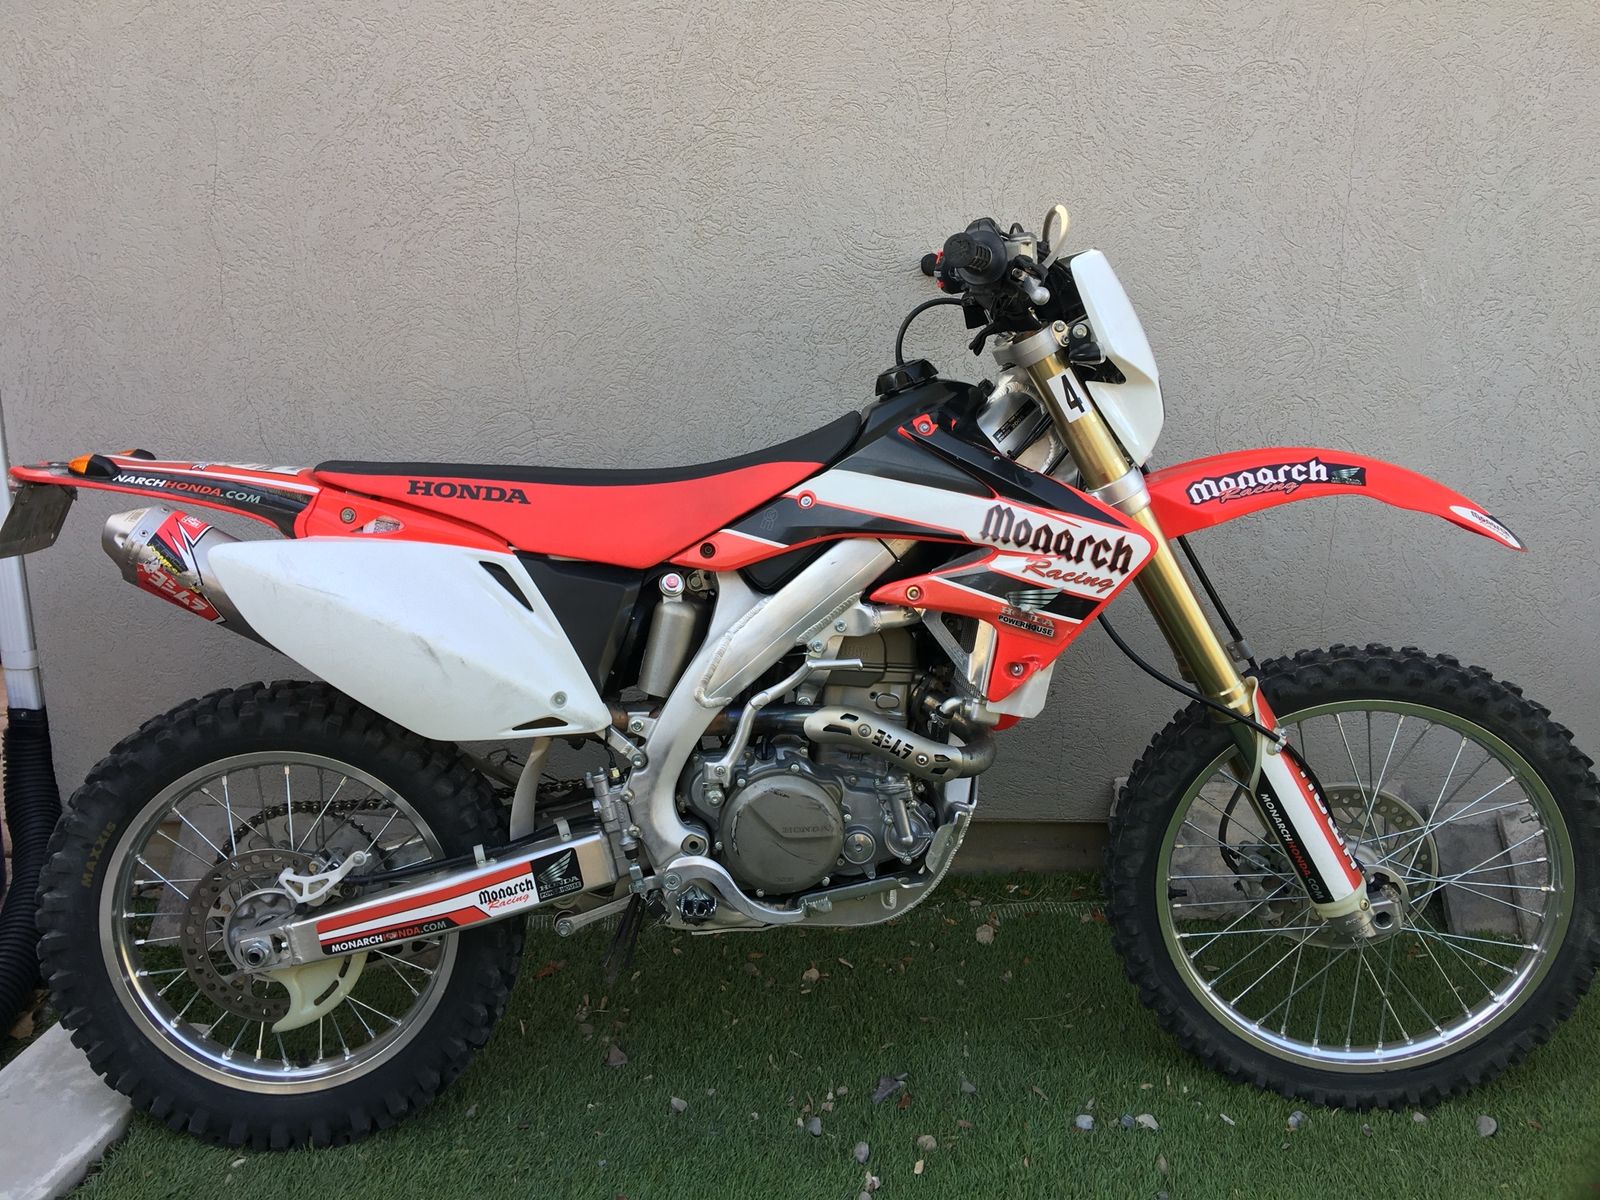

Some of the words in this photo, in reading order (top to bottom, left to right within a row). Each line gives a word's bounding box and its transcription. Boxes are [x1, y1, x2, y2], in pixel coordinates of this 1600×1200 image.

[1059, 374, 1086, 413] 4
[406, 480, 532, 505] HONDA
[1191, 459, 1329, 504] Monarch
[979, 504, 1134, 576] Monarch
[1022, 557, 1115, 594] Racing
[998, 614, 1054, 637] POWERHOUSE
[1260, 793, 1326, 900] MONARCHHONDA.COM
[478, 878, 535, 905] Monarch
[487, 892, 530, 912] Racing
